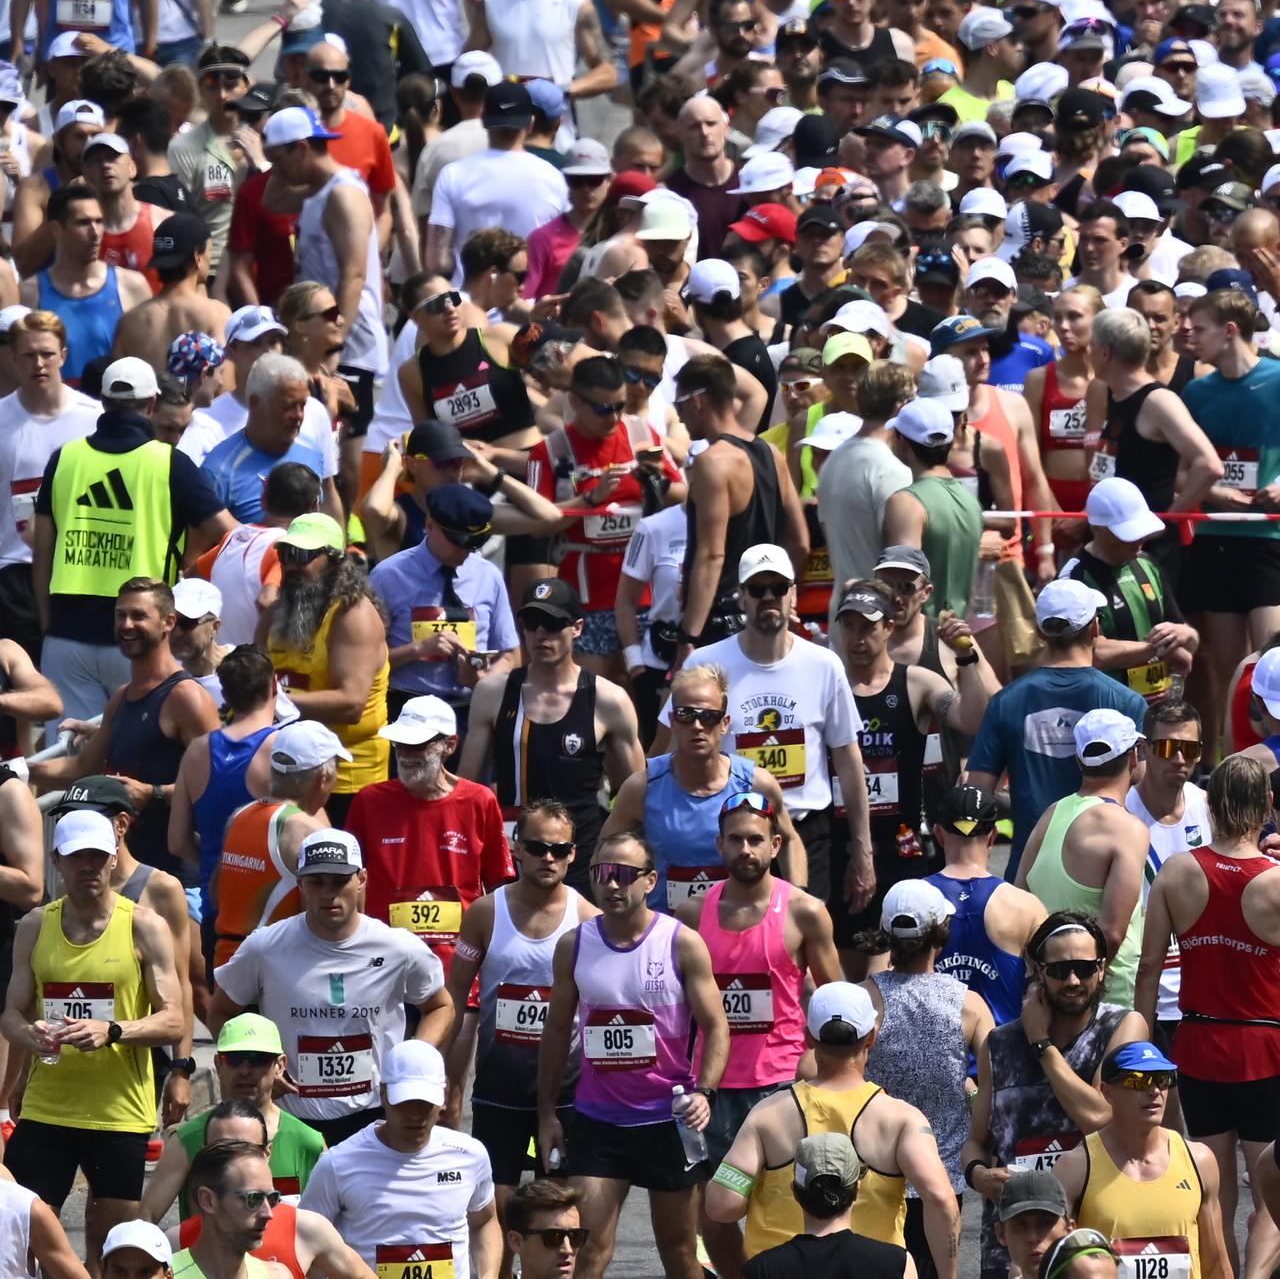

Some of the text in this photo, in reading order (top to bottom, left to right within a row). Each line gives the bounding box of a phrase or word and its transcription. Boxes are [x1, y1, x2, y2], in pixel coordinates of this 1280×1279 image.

[448, 391, 481, 418] 2893
[600, 515, 631, 531] 2521
[65, 529, 136, 552] STOCKHOLM
[65, 548, 134, 571] MARATHON
[740, 693, 797, 714] STOCKHOLM
[757, 748, 787, 770] 340
[306, 846, 345, 858] UMARA
[411, 904, 441, 924] 392
[1181, 933, 1269, 957] Björnstorps IF
[644, 980, 665, 992] OTSO
[63, 1002, 93, 1021] 705
[290, 1005, 381, 1020] RUNNER 2019
[516, 1004, 548, 1026] 694
[722, 993, 752, 1015] 620
[603, 1028, 634, 1050] 805
[317, 1055, 356, 1078] 1332
[437, 1171, 462, 1183] MSA
[402, 1264, 434, 1279] 484
[1135, 1257, 1169, 1279] 1128
